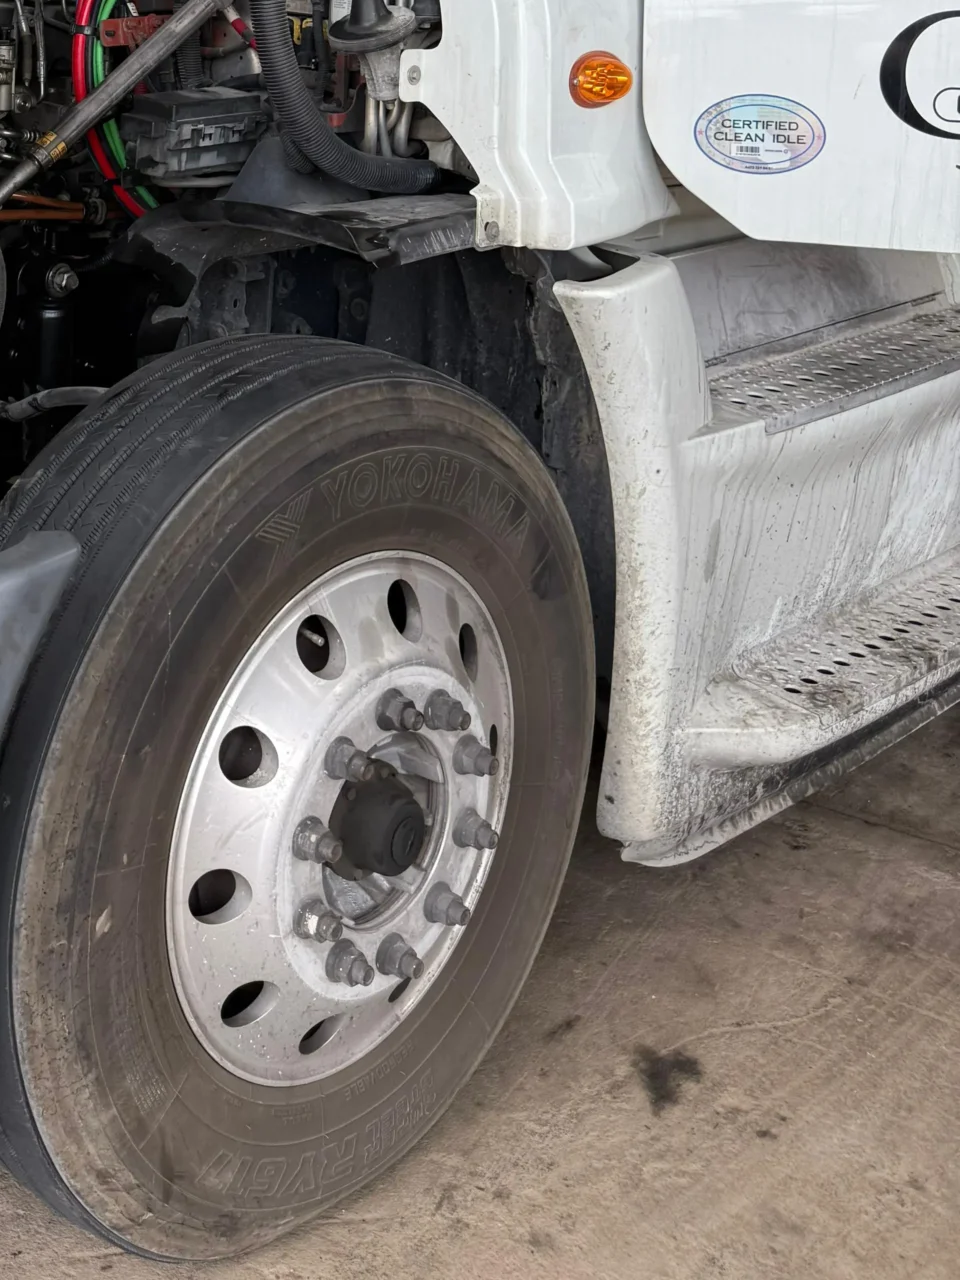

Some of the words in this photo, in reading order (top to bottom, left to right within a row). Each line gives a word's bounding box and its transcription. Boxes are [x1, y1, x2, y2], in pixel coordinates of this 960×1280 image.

[721, 119, 799, 131] CERTIFIED
[714, 132, 764, 142] CLEAN
[772, 134, 806, 144] IDLE
[320, 452, 531, 550] YOKOHAMA
